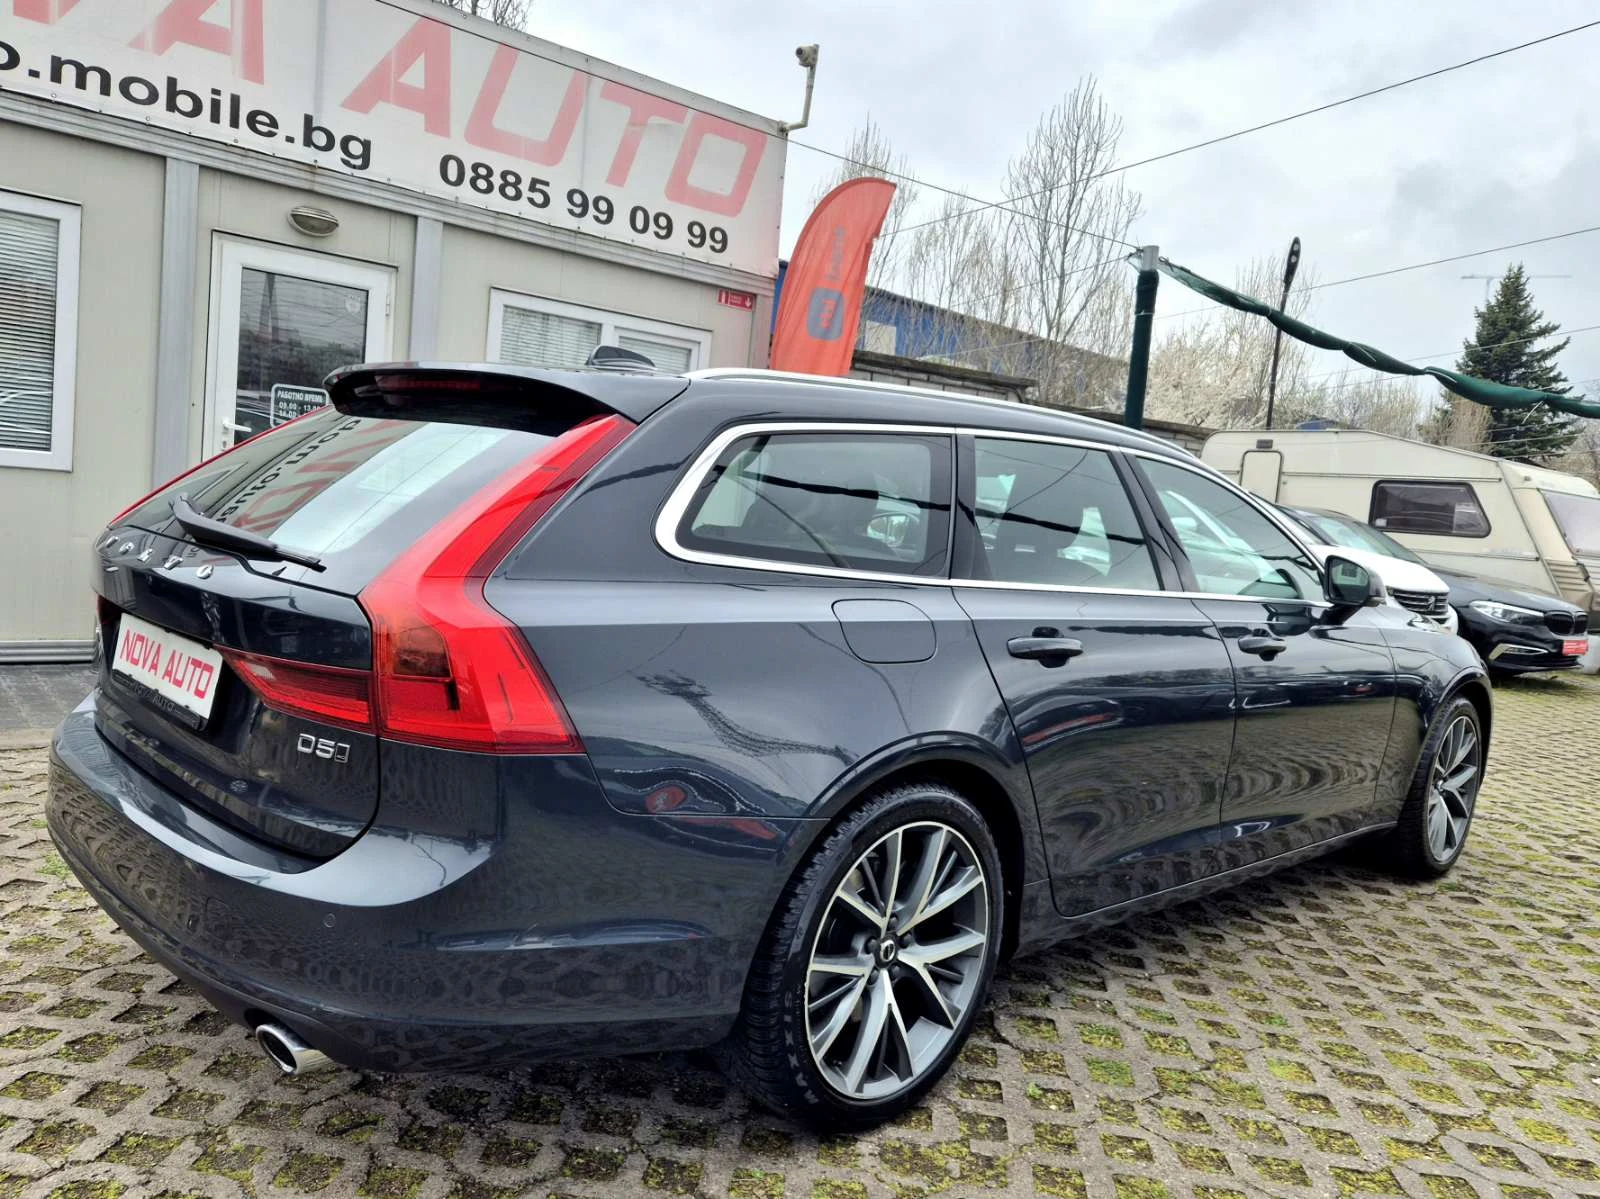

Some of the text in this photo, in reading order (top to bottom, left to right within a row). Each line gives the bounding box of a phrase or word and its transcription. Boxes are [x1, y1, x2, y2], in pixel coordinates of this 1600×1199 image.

[341, 15, 768, 218] AUTO
[439, 153, 729, 255] 0885 99 09 99
[105, 535, 214, 580] VOLVO
[120, 629, 214, 699] NOVA AUTO
[297, 732, 336, 759] D5
